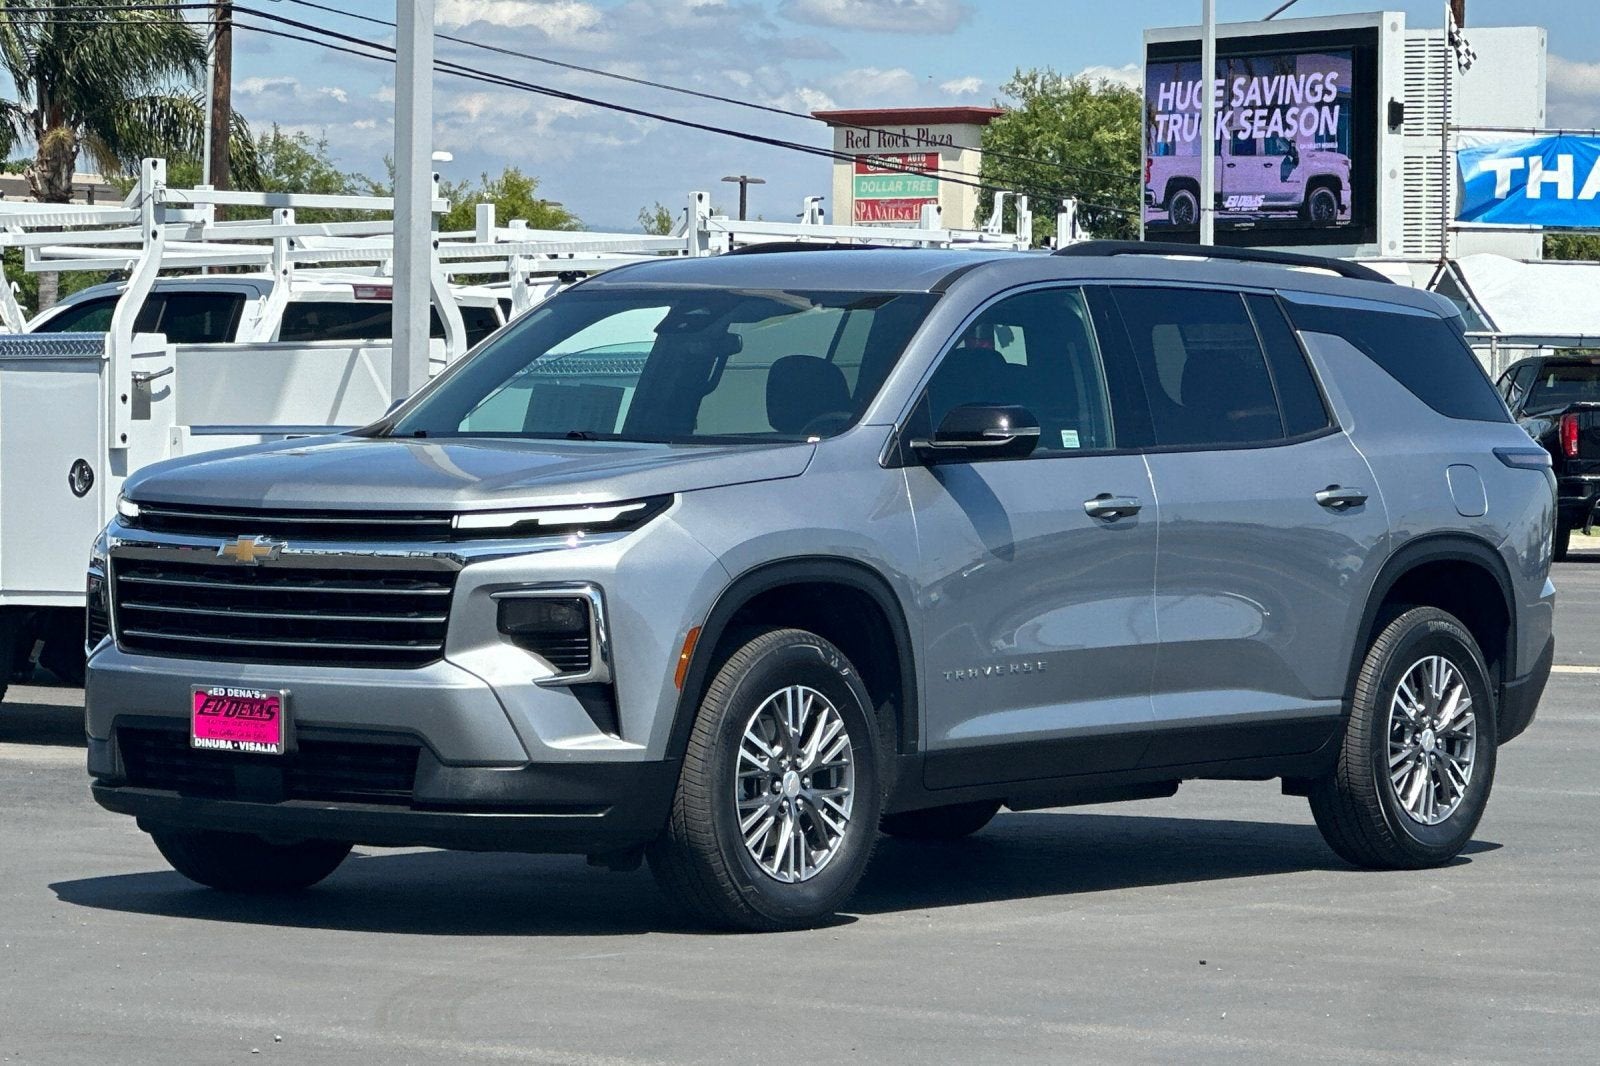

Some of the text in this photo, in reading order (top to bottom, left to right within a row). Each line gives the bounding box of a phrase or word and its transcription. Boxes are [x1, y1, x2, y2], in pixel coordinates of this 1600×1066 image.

[1231, 71, 1339, 108] SAVINGS
[1155, 105, 1340, 143] TRUK SEASON
[845, 127, 953, 149] Red Rock Plaza
[907, 154, 926, 162] AUTO
[860, 180, 933, 193] DOLLAR TREE
[855, 201, 873, 220] SPA
[874, 203, 904, 220] NAILS
[943, 661, 1048, 680] TRAVERSE
[213, 687, 260, 698] ED DENA'S
[195, 738, 278, 753] DINUBA VISALIA
